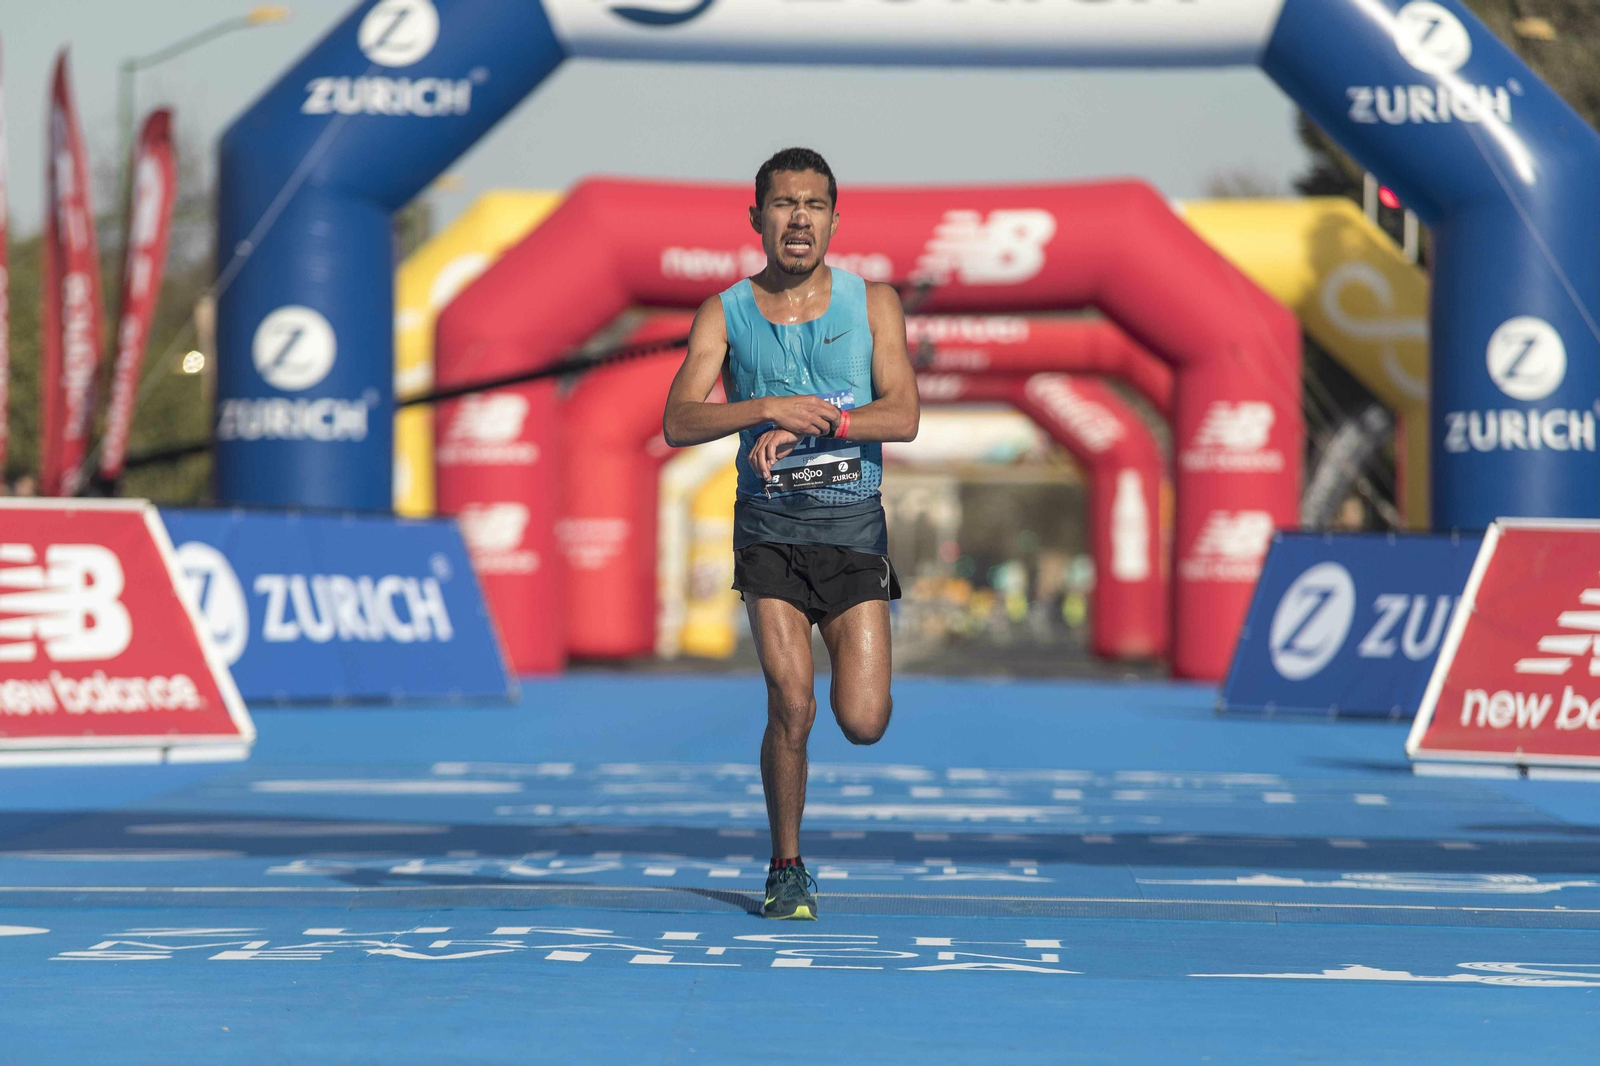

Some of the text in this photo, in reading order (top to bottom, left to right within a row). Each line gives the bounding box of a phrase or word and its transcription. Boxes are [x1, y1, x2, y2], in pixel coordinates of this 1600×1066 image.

[301, 76, 472, 117] ZURICH
[1346, 83, 1513, 125] ZURICH
[217, 397, 369, 442] ZURICH
[1445, 408, 1596, 452] ZURICH
[832, 472, 858, 482] ZURICH
[255, 574, 454, 643] ZURICH
[1358, 594, 1463, 661] ZU
[1460, 688, 1552, 730] new
[105, 926, 1067, 949] ZURICH
[49, 948, 1086, 975] SEVILLA
